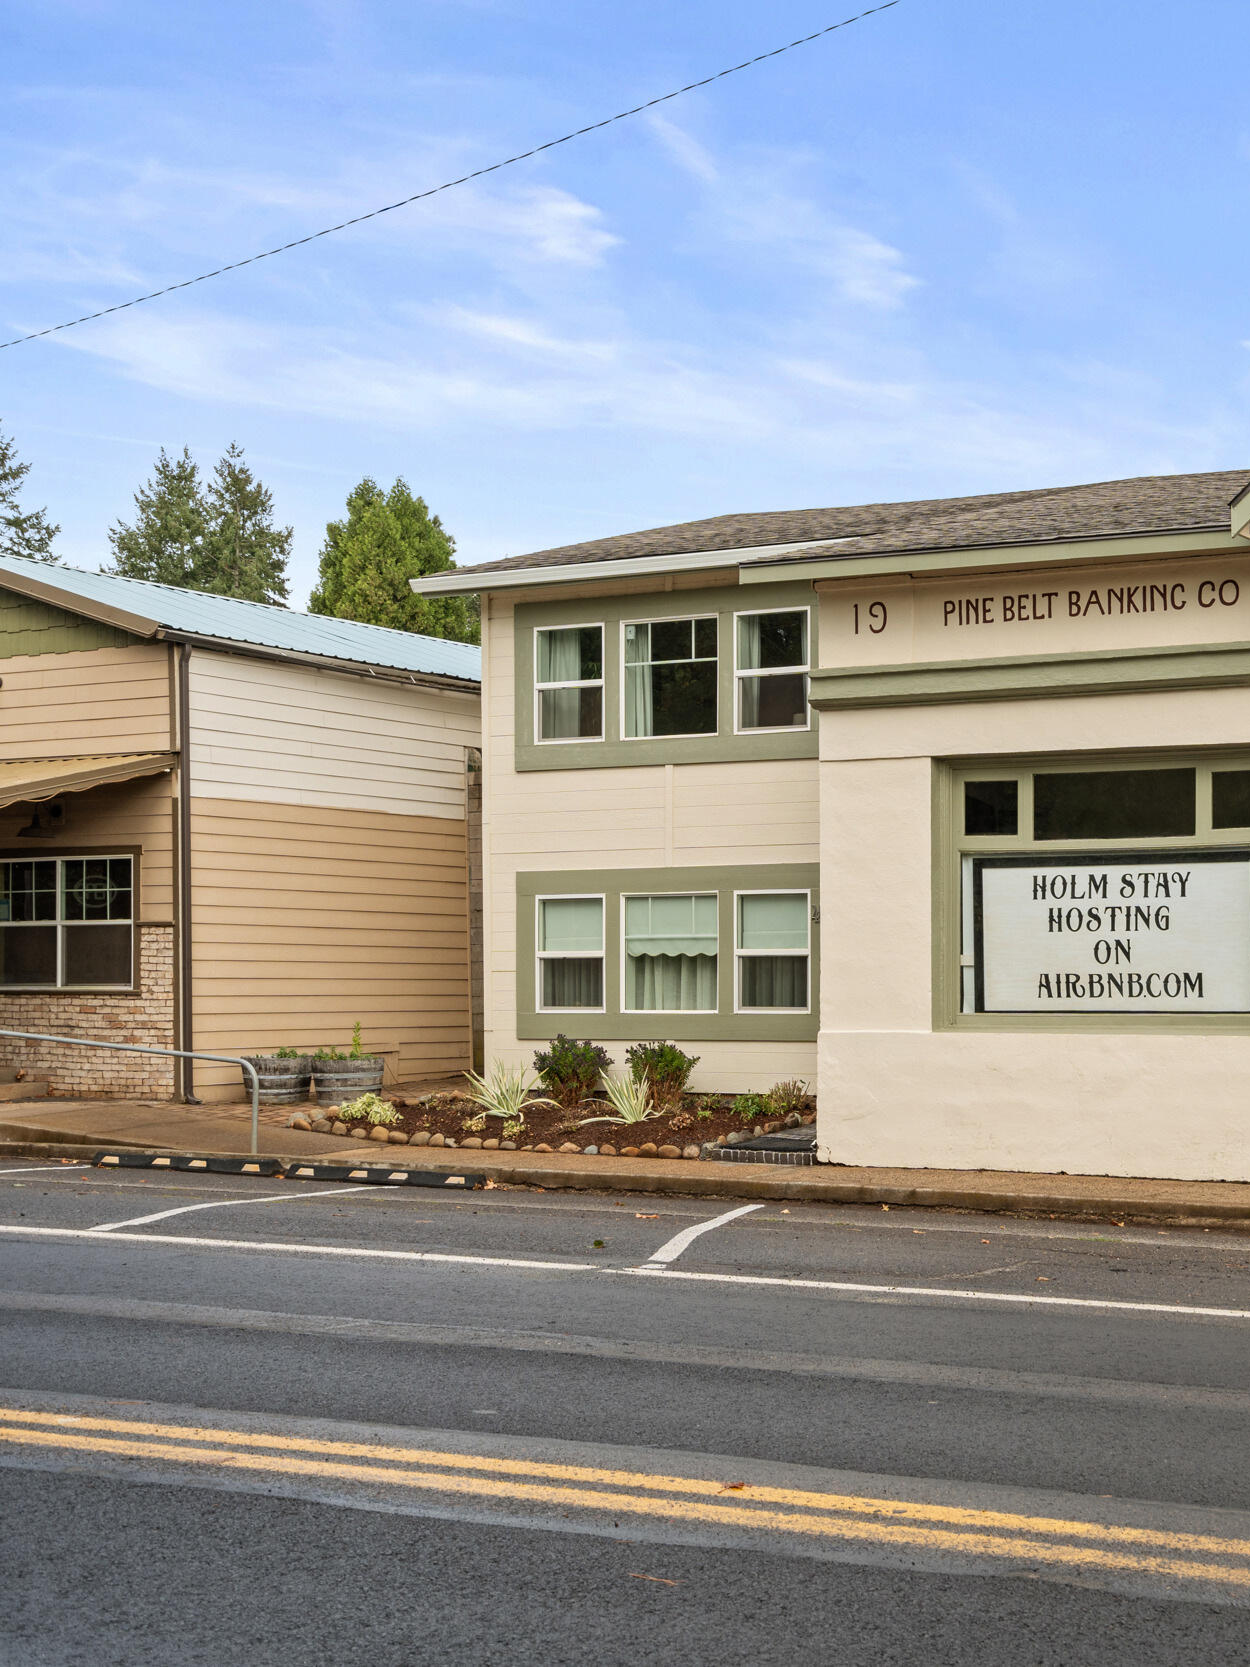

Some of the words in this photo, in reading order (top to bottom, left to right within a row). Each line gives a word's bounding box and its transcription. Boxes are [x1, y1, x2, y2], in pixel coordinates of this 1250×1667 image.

[943, 597, 995, 627] PINE
[1002, 592, 1059, 623] BELT
[1067, 582, 1187, 618] BANKING
[1197, 578, 1240, 609] CO
[852, 601, 888, 635] 19
[1032, 873, 1108, 900] HOLM
[1119, 871, 1191, 898] STAY
[1048, 905, 1170, 933] HOSTING
[1093, 938, 1132, 965] ON
[1038, 972, 1204, 999] AIRBNB.COM
